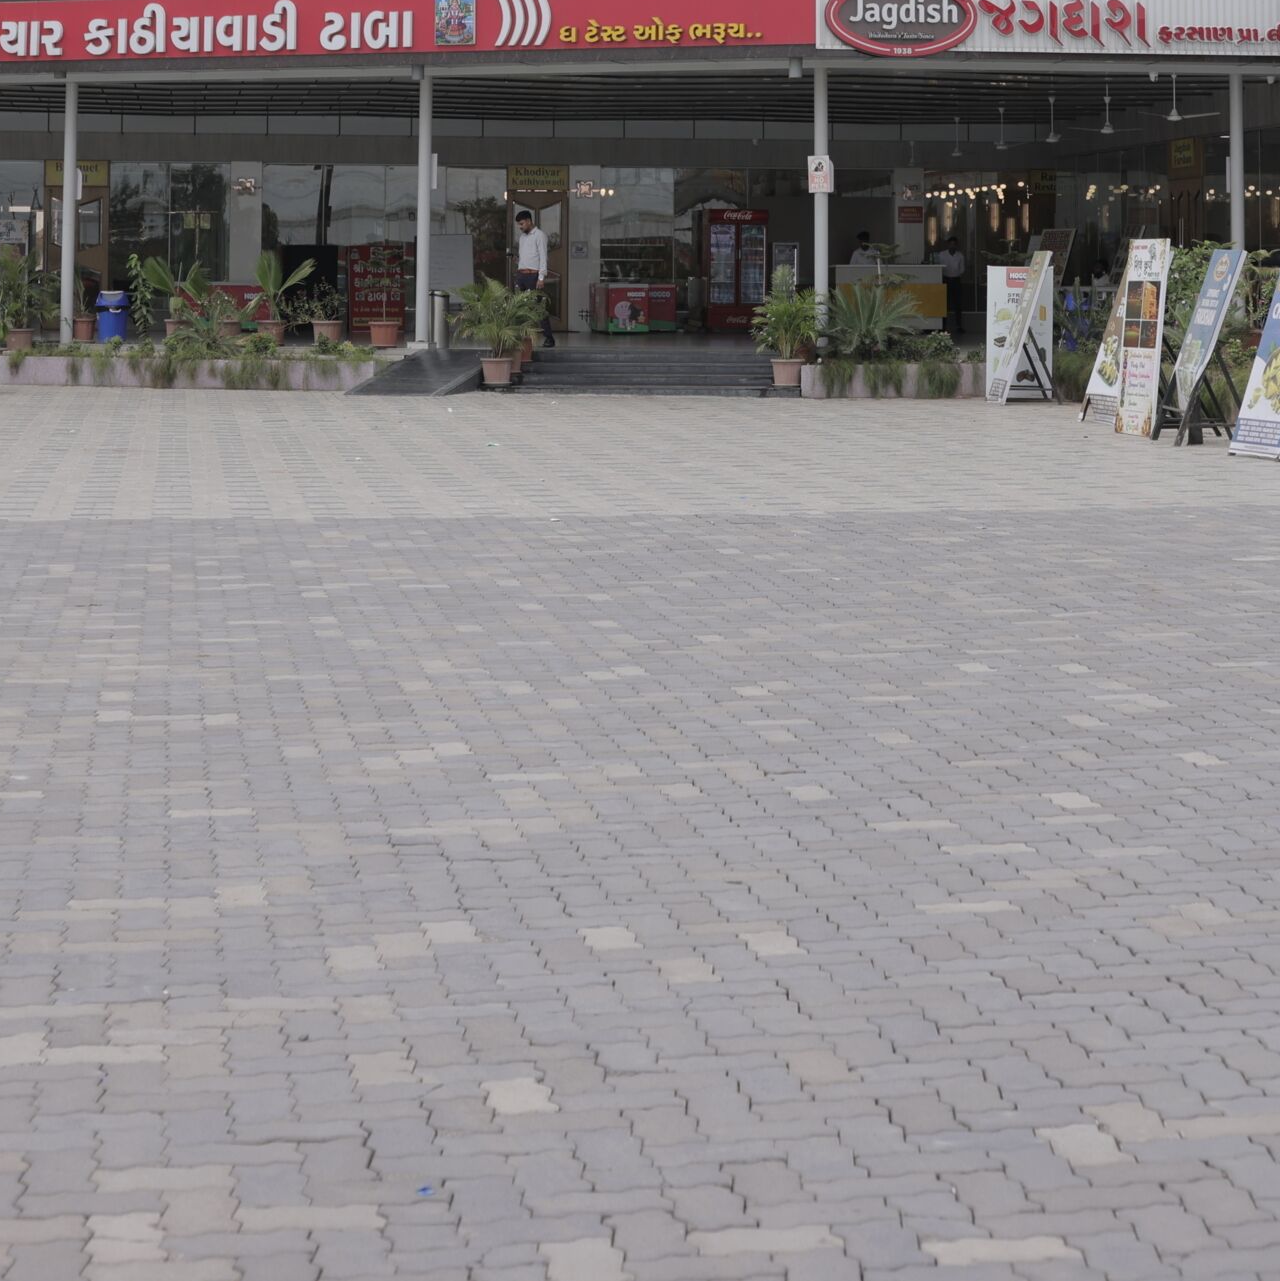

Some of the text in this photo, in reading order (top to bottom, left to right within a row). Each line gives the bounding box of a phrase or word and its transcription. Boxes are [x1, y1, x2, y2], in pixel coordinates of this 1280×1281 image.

[83, 0, 297, 56] કાઠીયાવાડી
[319, 9, 413, 52] ઢાબા
[584, 18, 627, 43] ટેસ્ટ
[893, 47, 913, 55] 1938
[514, 167, 561, 178] Khodiyar
